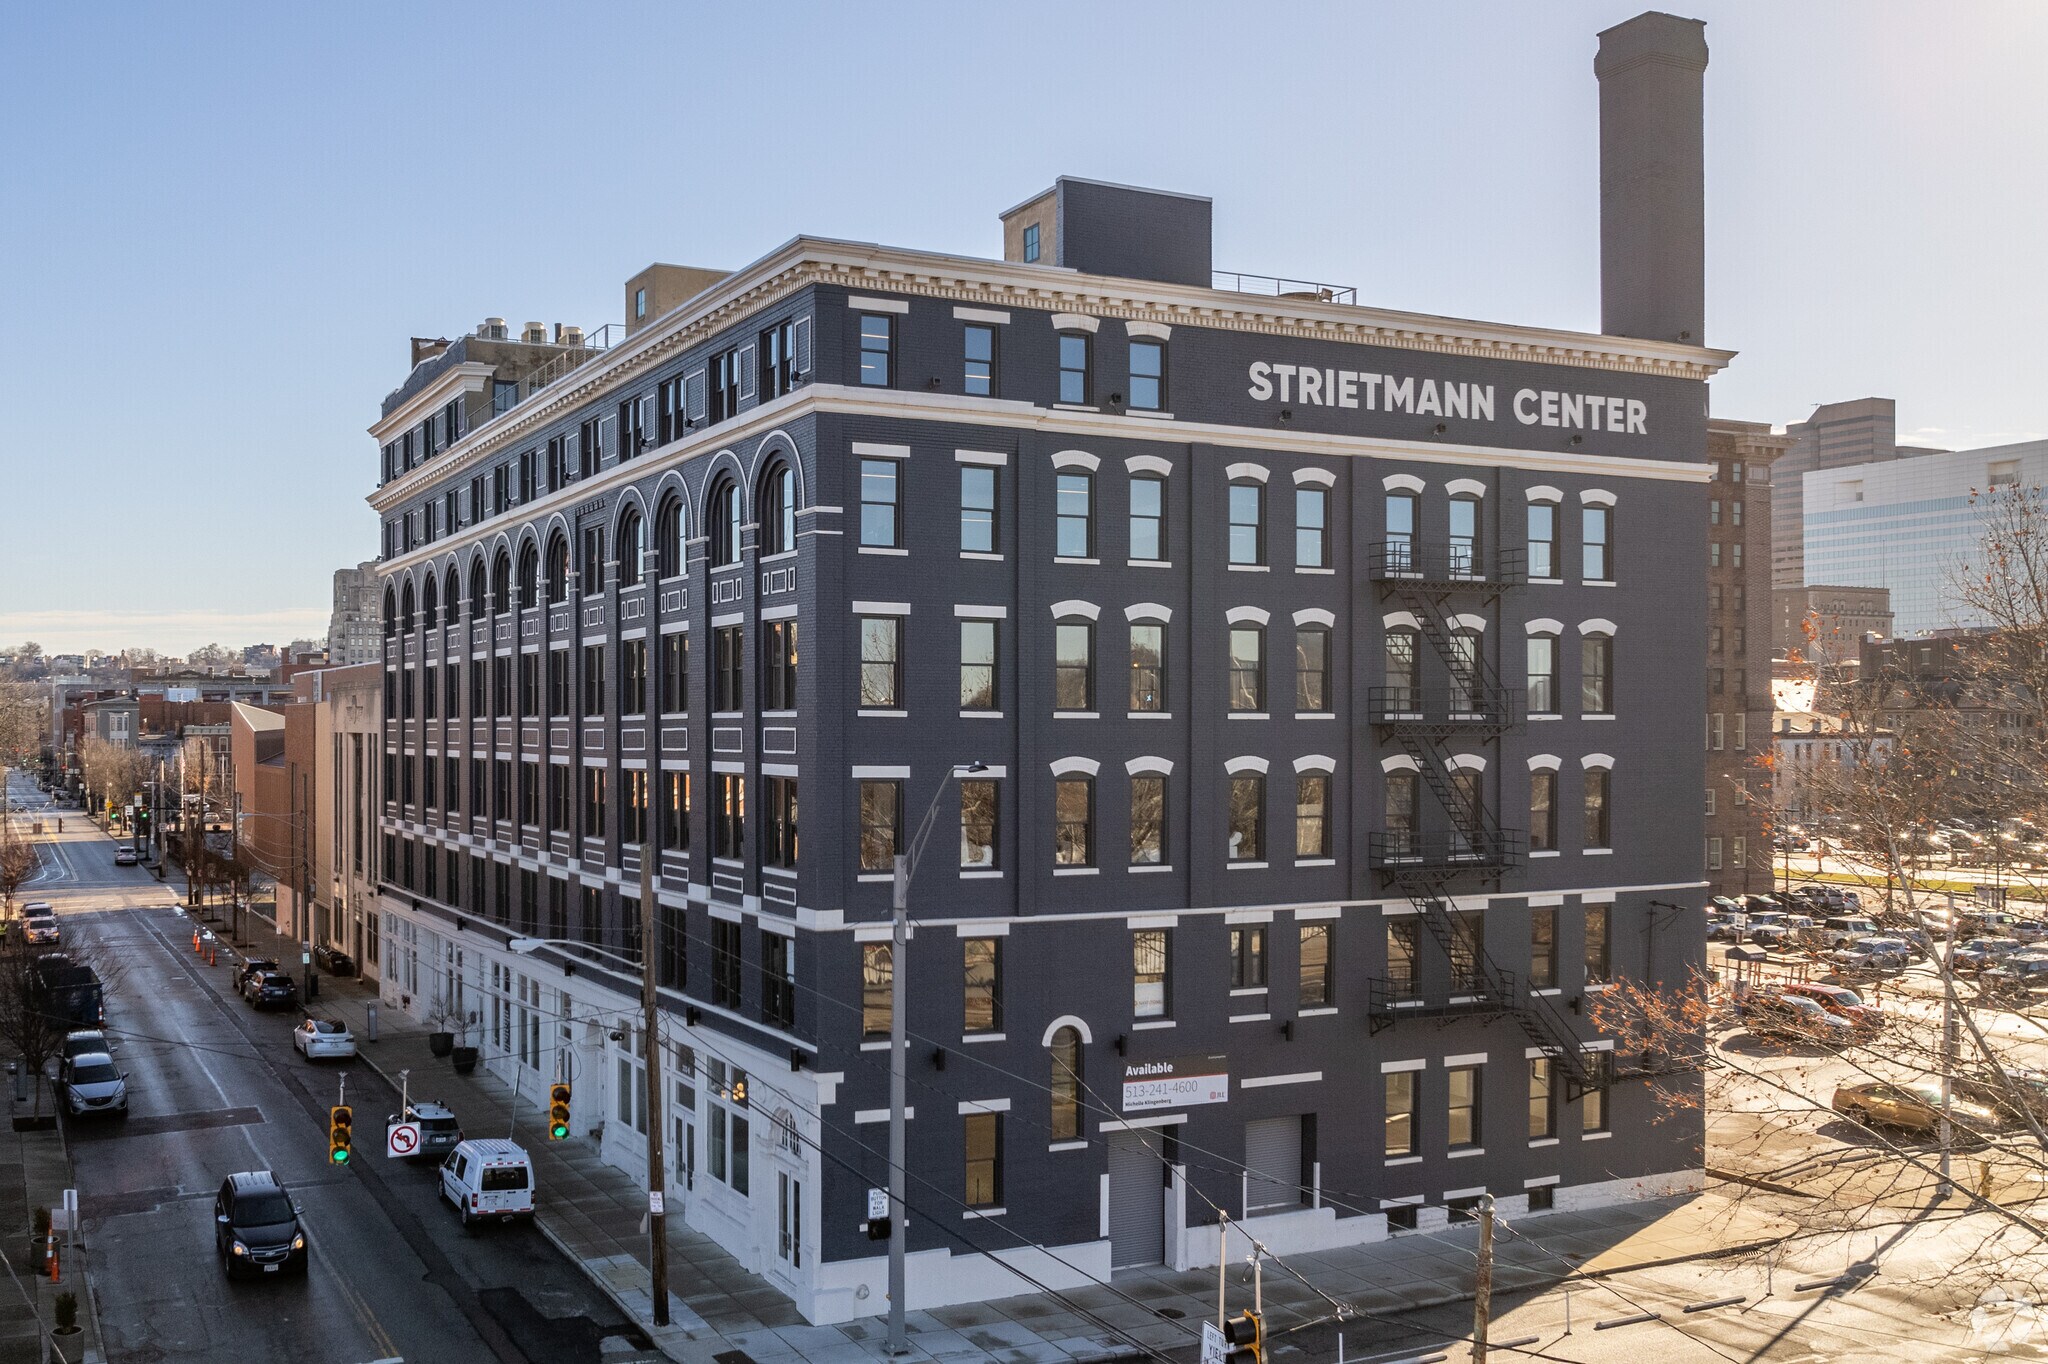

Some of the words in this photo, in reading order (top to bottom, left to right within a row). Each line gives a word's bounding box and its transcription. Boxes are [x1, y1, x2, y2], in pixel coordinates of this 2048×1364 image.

[1248, 361, 1494, 421] STRIETMANN
[1513, 388, 1647, 435] CENTER
[1125, 1062, 1173, 1076] Available
[1125, 1080, 1198, 1098] 513-241-4600
[1207, 1329, 1217, 1343] LEFT
